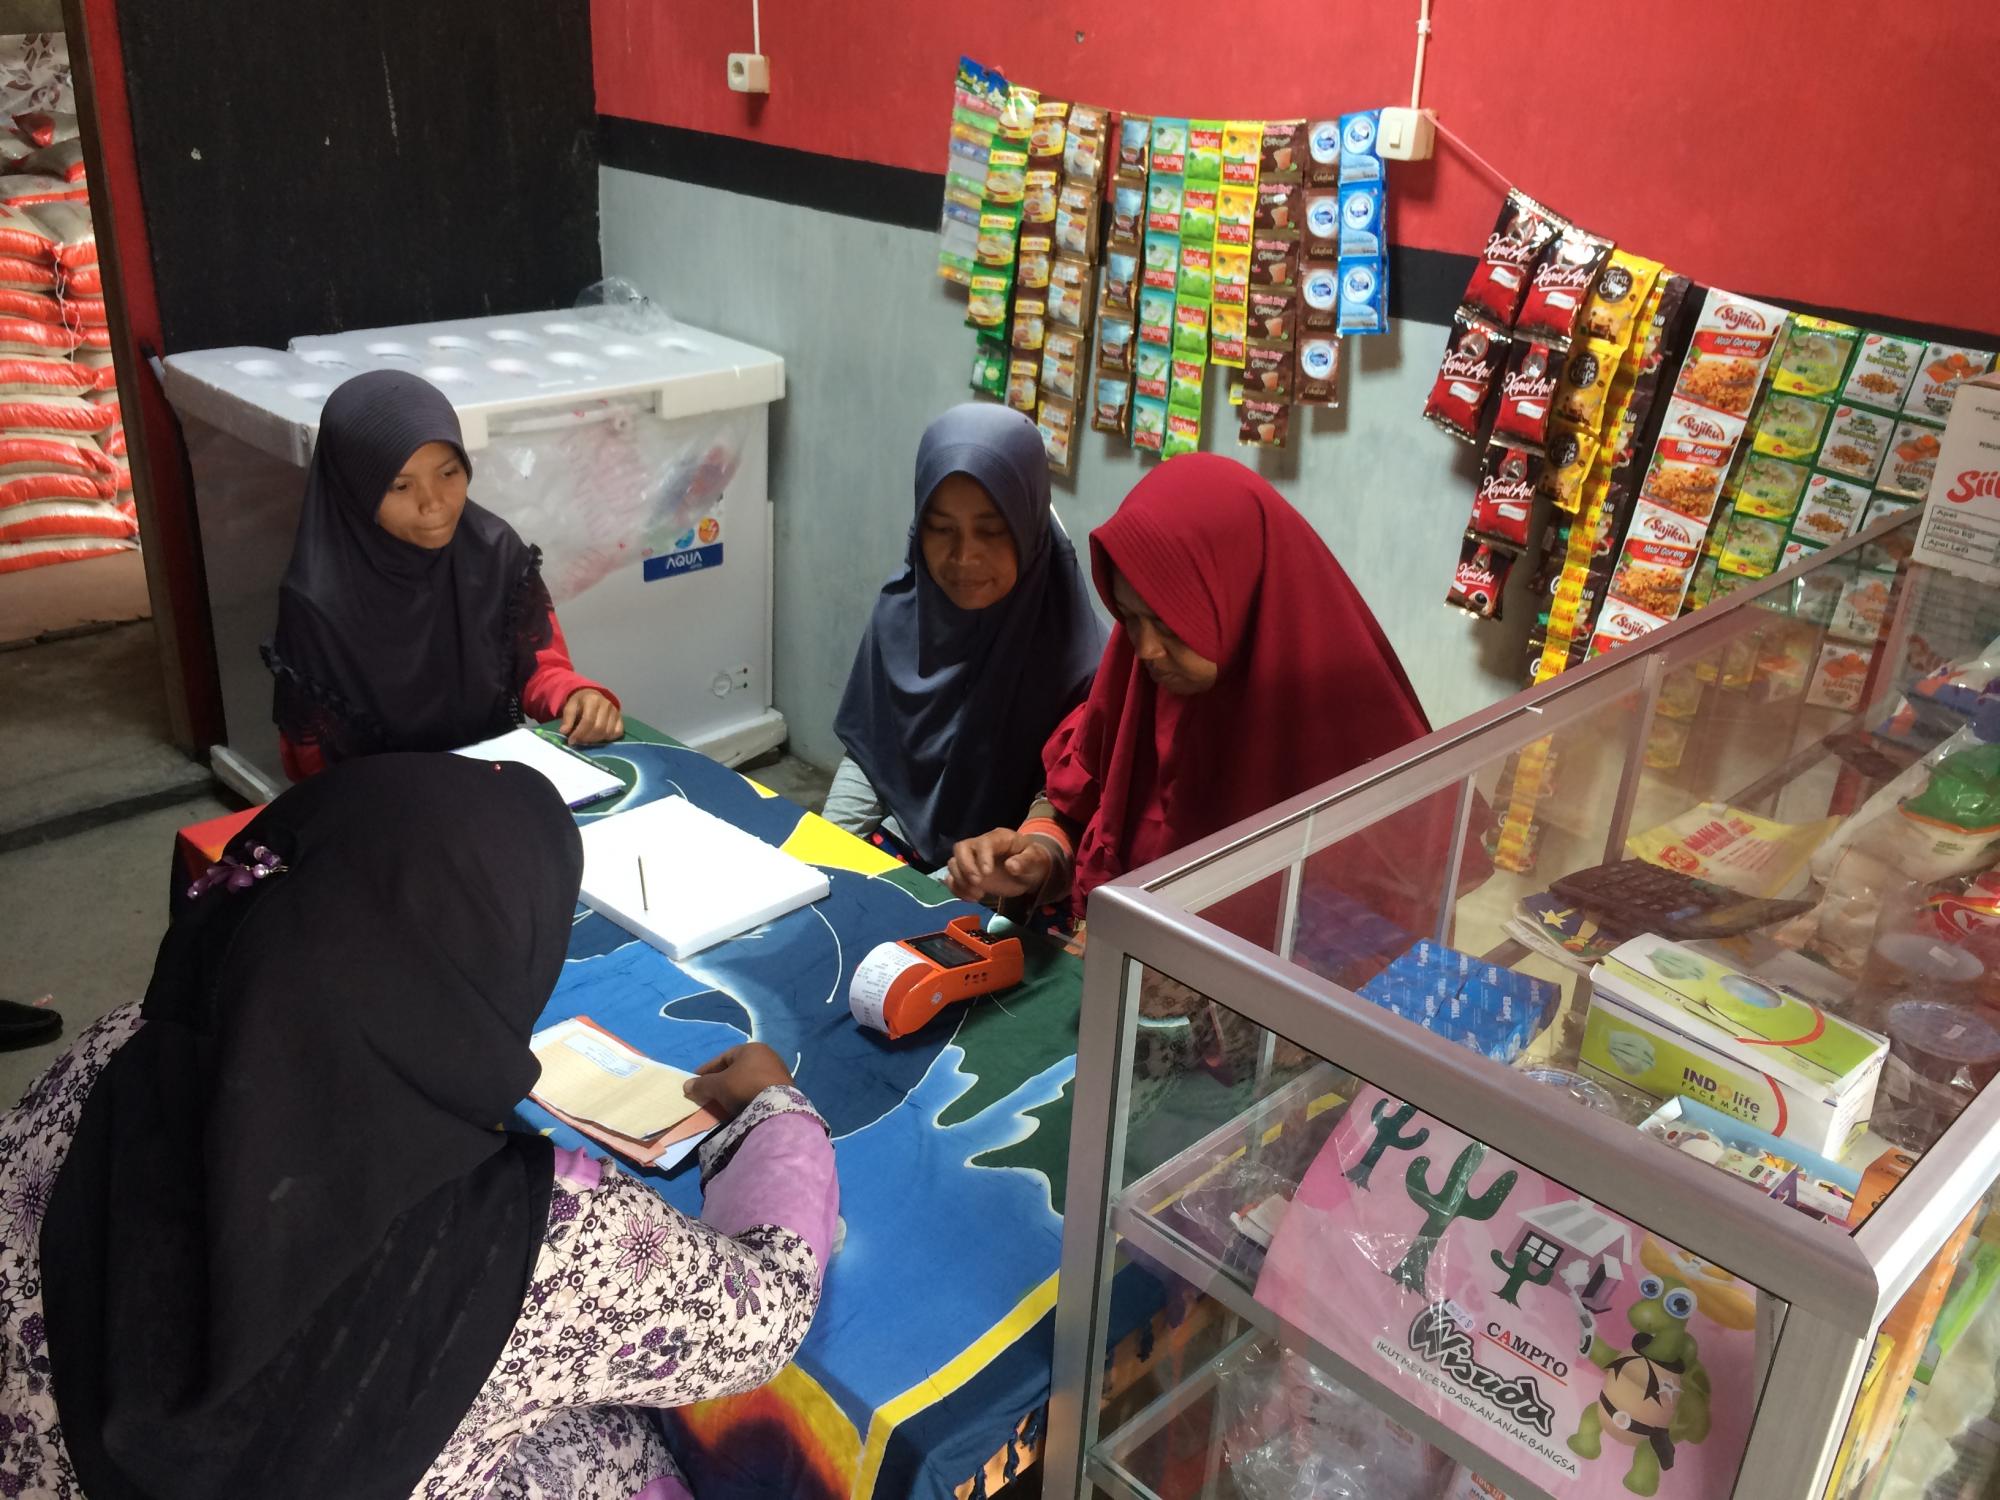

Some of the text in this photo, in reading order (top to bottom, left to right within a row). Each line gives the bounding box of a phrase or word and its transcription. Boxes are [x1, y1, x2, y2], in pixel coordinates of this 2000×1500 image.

[1533, 263, 1570, 287] Kapal
[1604, 269, 1629, 284] Tora
[1721, 307, 1761, 331] Sajiku
[1442, 349, 1473, 375] Kapal
[1504, 372, 1535, 396] Kapal
[1684, 416, 1721, 440] Sajiku
[1481, 475, 1516, 499] Kapal
[1650, 519, 1687, 543] Sajiku
[666, 552, 702, 570] AQUA
[1681, 1081, 1758, 1122] FACE MASK
[1486, 1322, 1569, 1378] CAMPTO
[1376, 1341, 1400, 1361] IKUT
[1494, 1417, 1527, 1444] ANAK
[1527, 1438, 1577, 1475] BANGSA
